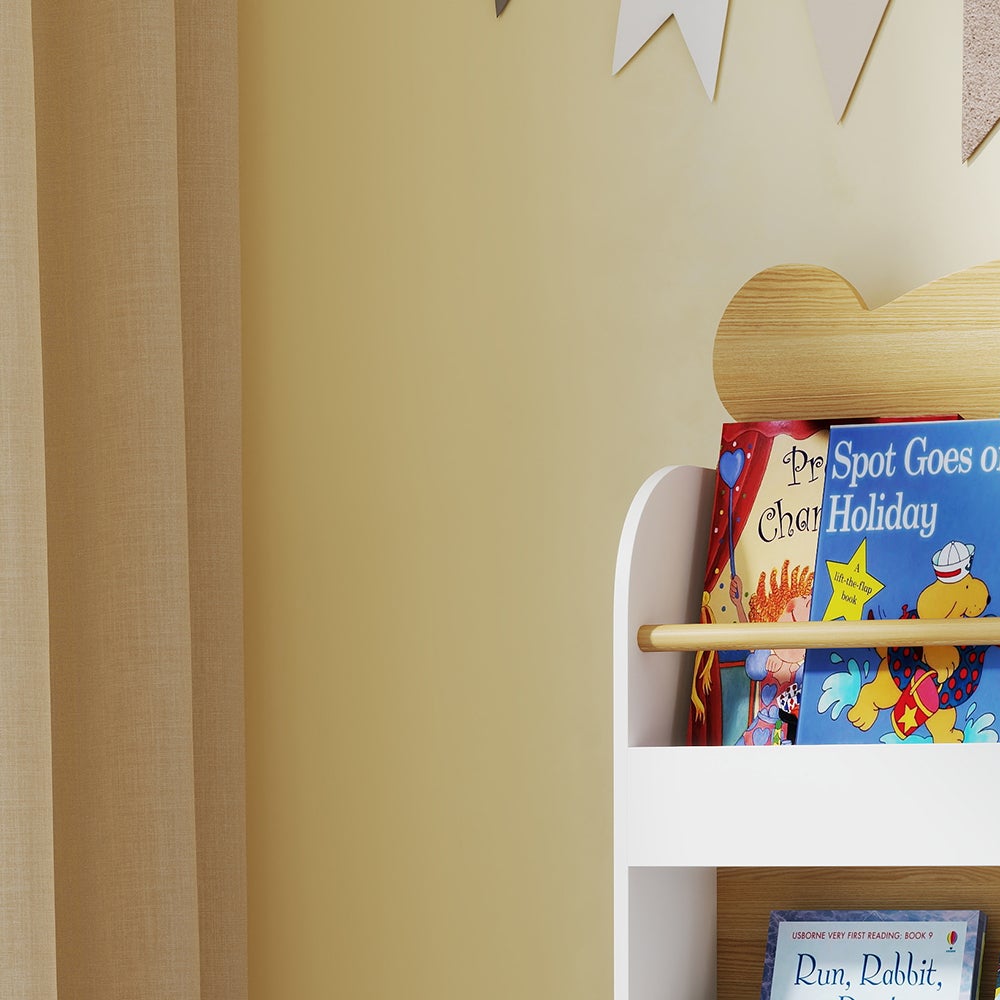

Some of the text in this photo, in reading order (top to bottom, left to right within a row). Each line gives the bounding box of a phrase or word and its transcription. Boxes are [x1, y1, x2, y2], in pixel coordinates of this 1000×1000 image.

[783, 446, 826, 486] Pr
[832, 440, 896, 487] Spot
[904, 436, 972, 476] Goes
[758, 499, 822, 543] Char
[826, 492, 937, 538] Holiday
[834, 571, 872, 595] lift-the-flap
[854, 563, 860, 573] A
[841, 590, 857, 604] book
[792, 931, 933, 940] USBORNE VERY FIRST READING: BOOK 9
[794, 951, 942, 991] Run, Rabbit,
